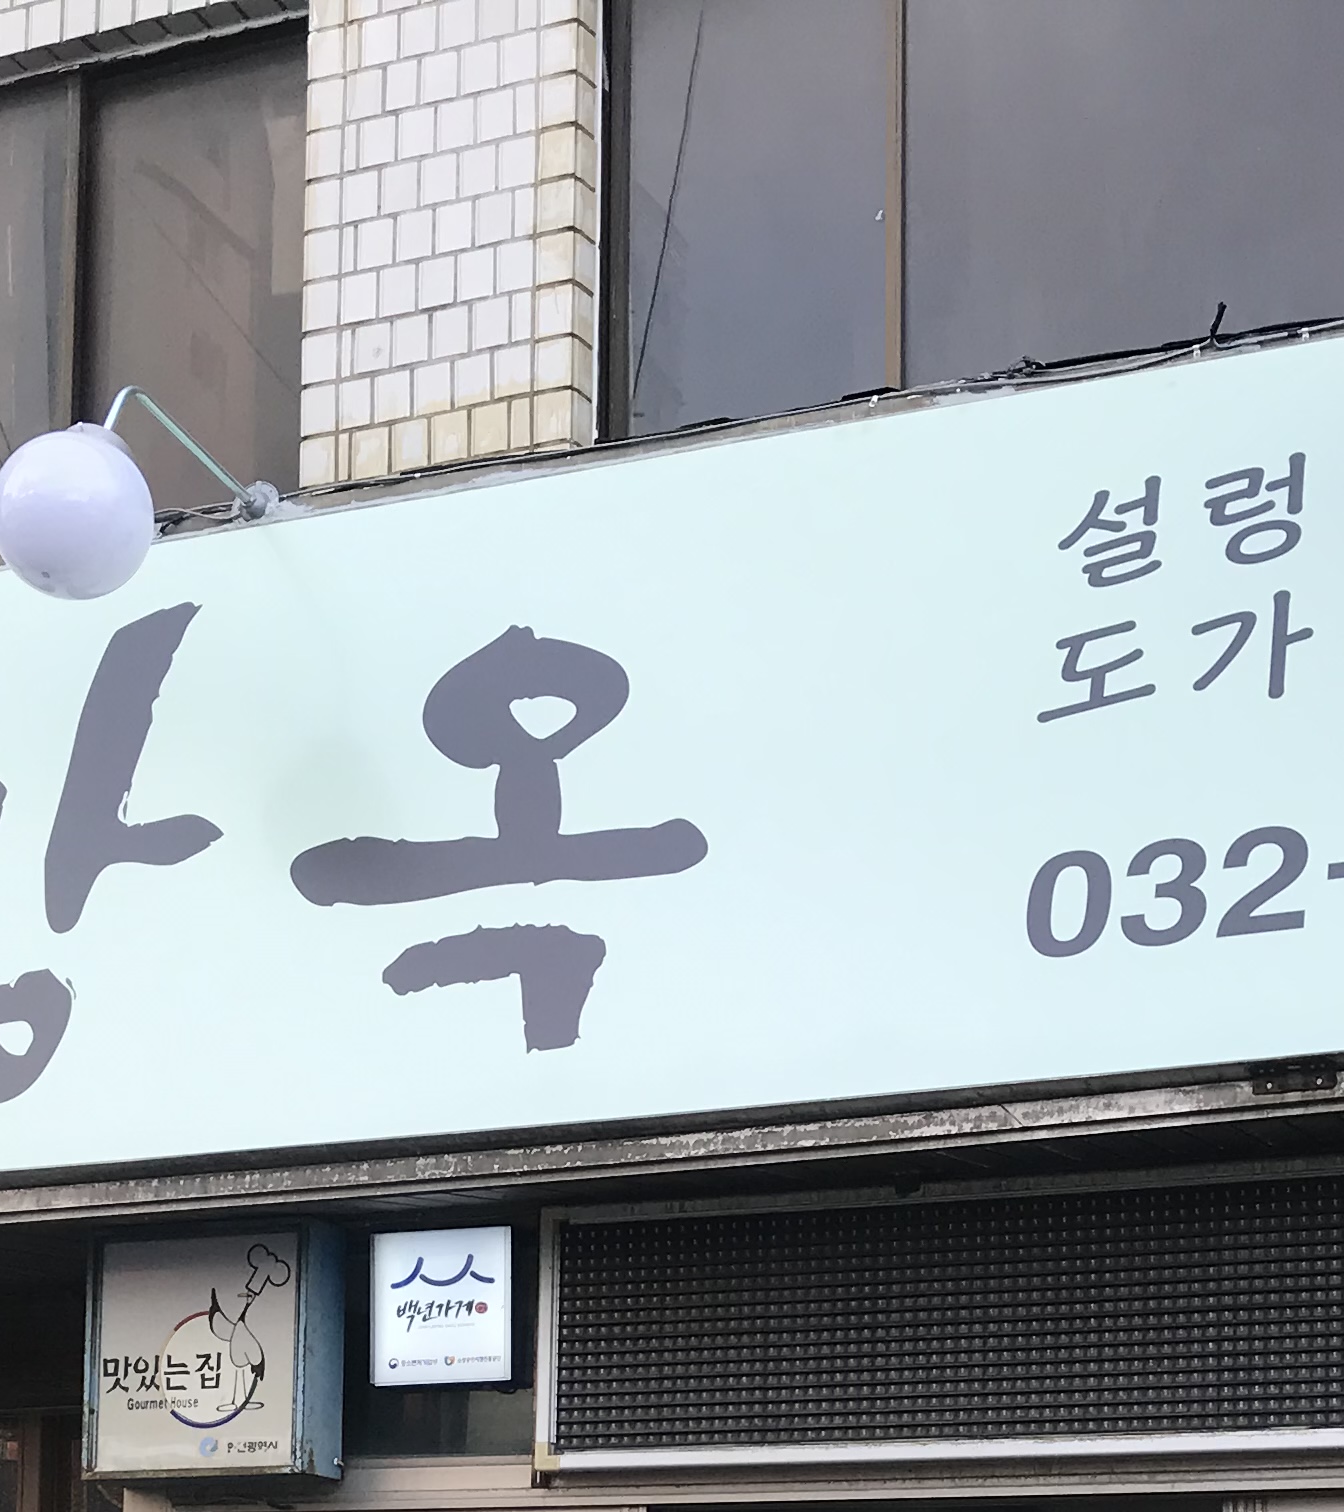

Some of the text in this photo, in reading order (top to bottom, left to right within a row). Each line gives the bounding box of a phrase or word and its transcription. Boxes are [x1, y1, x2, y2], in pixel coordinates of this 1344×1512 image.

[397, 1299, 475, 1333] 백년가게
[103, 1352, 222, 1394] 맛있는집
[127, 1397, 199, 1410] Gourmet House
